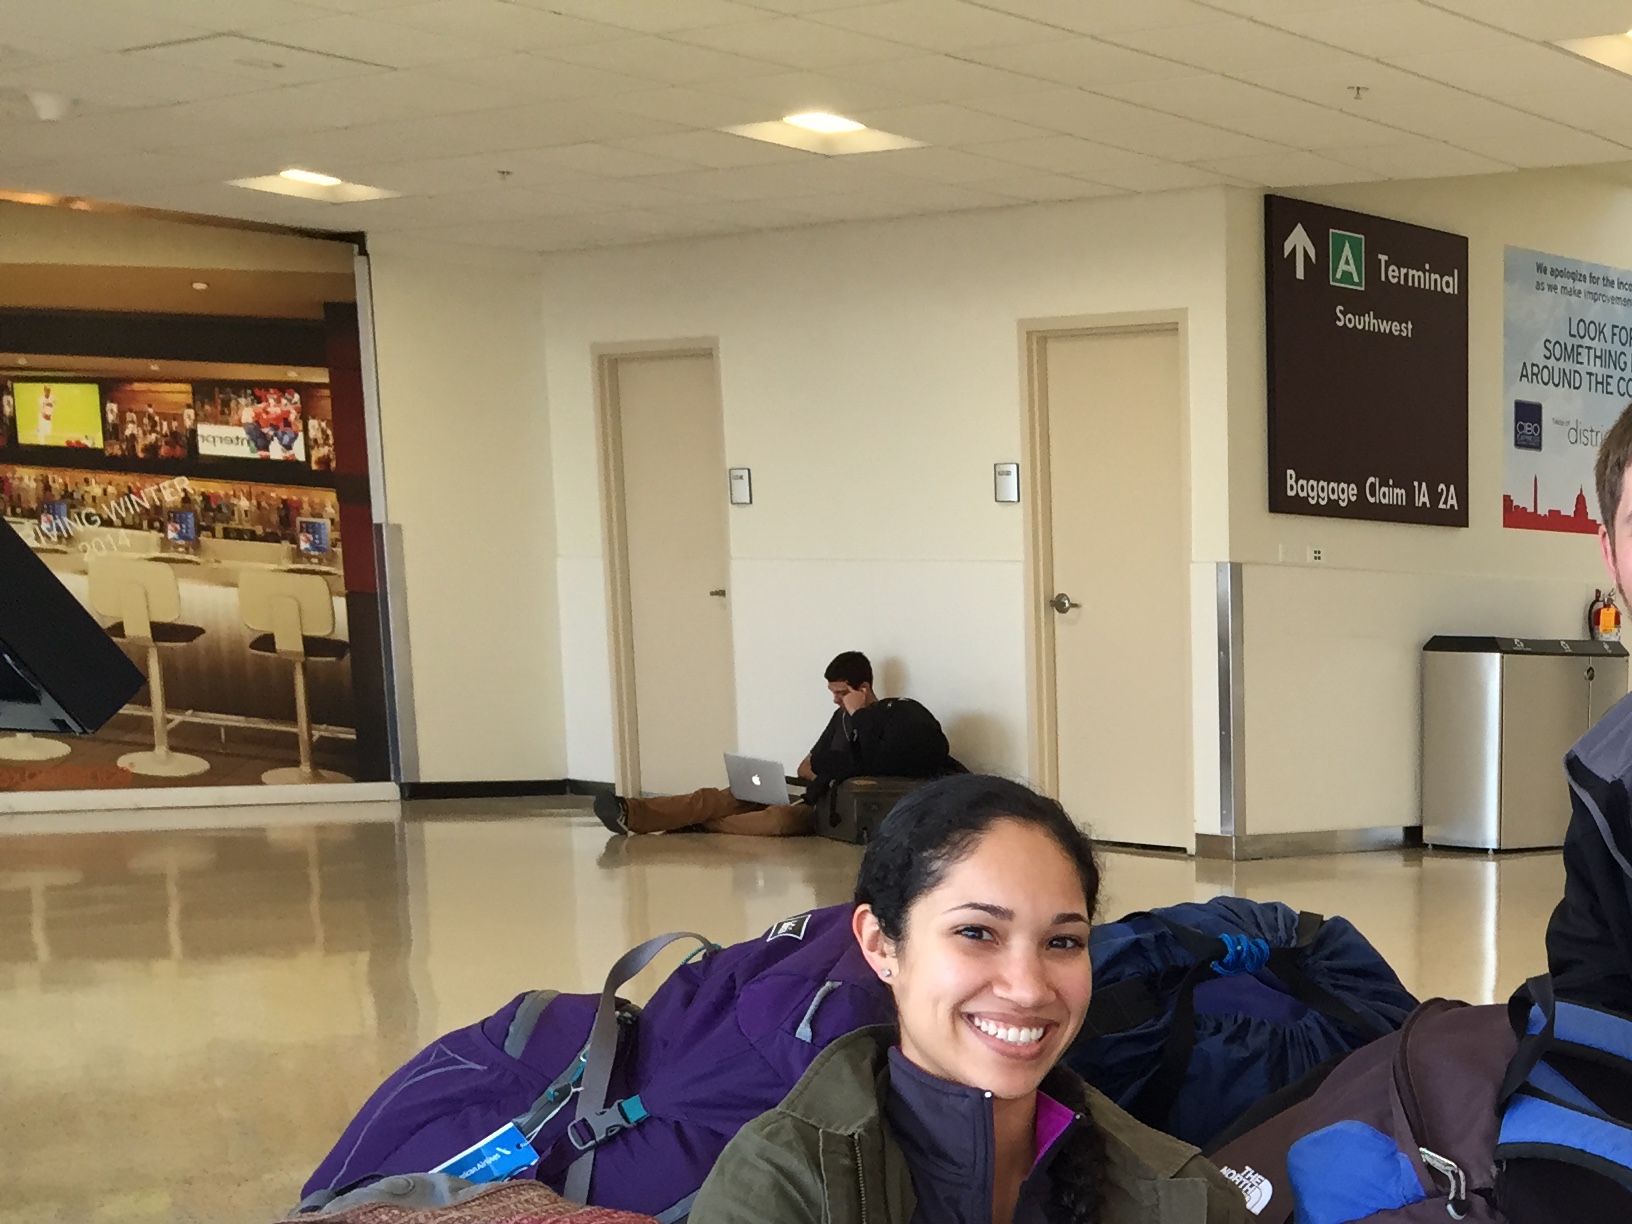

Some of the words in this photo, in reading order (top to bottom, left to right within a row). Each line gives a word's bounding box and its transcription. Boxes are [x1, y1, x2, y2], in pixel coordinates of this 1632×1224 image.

[1335, 239, 1360, 283] A
[1377, 253, 1458, 295] Terminal
[1535, 262, 1548, 275] We
[1549, 266, 1587, 284] apologize
[1589, 272, 1600, 286] for
[1602, 275, 1615, 289] the
[1535, 281, 1545, 292] as
[1547, 283, 1559, 295] we
[1560, 283, 1582, 299] make
[1335, 305, 1413, 338] Southwest
[1568, 316, 1608, 343] LOOK
[1543, 338, 1628, 372] SOMETHING
[1519, 361, 1582, 390] AROUND
[1586, 371, 1614, 395] THE
[101, 475, 195, 523] WINTER
[1286, 469, 1358, 507] Baggage
[1365, 476, 1406, 506] Claim
[1413, 481, 1430, 508] 1A
[1438, 483, 1459, 510] 2A
[1220, 1165, 1256, 1196] NORTH
[1240, 1165, 1265, 1187] THE
